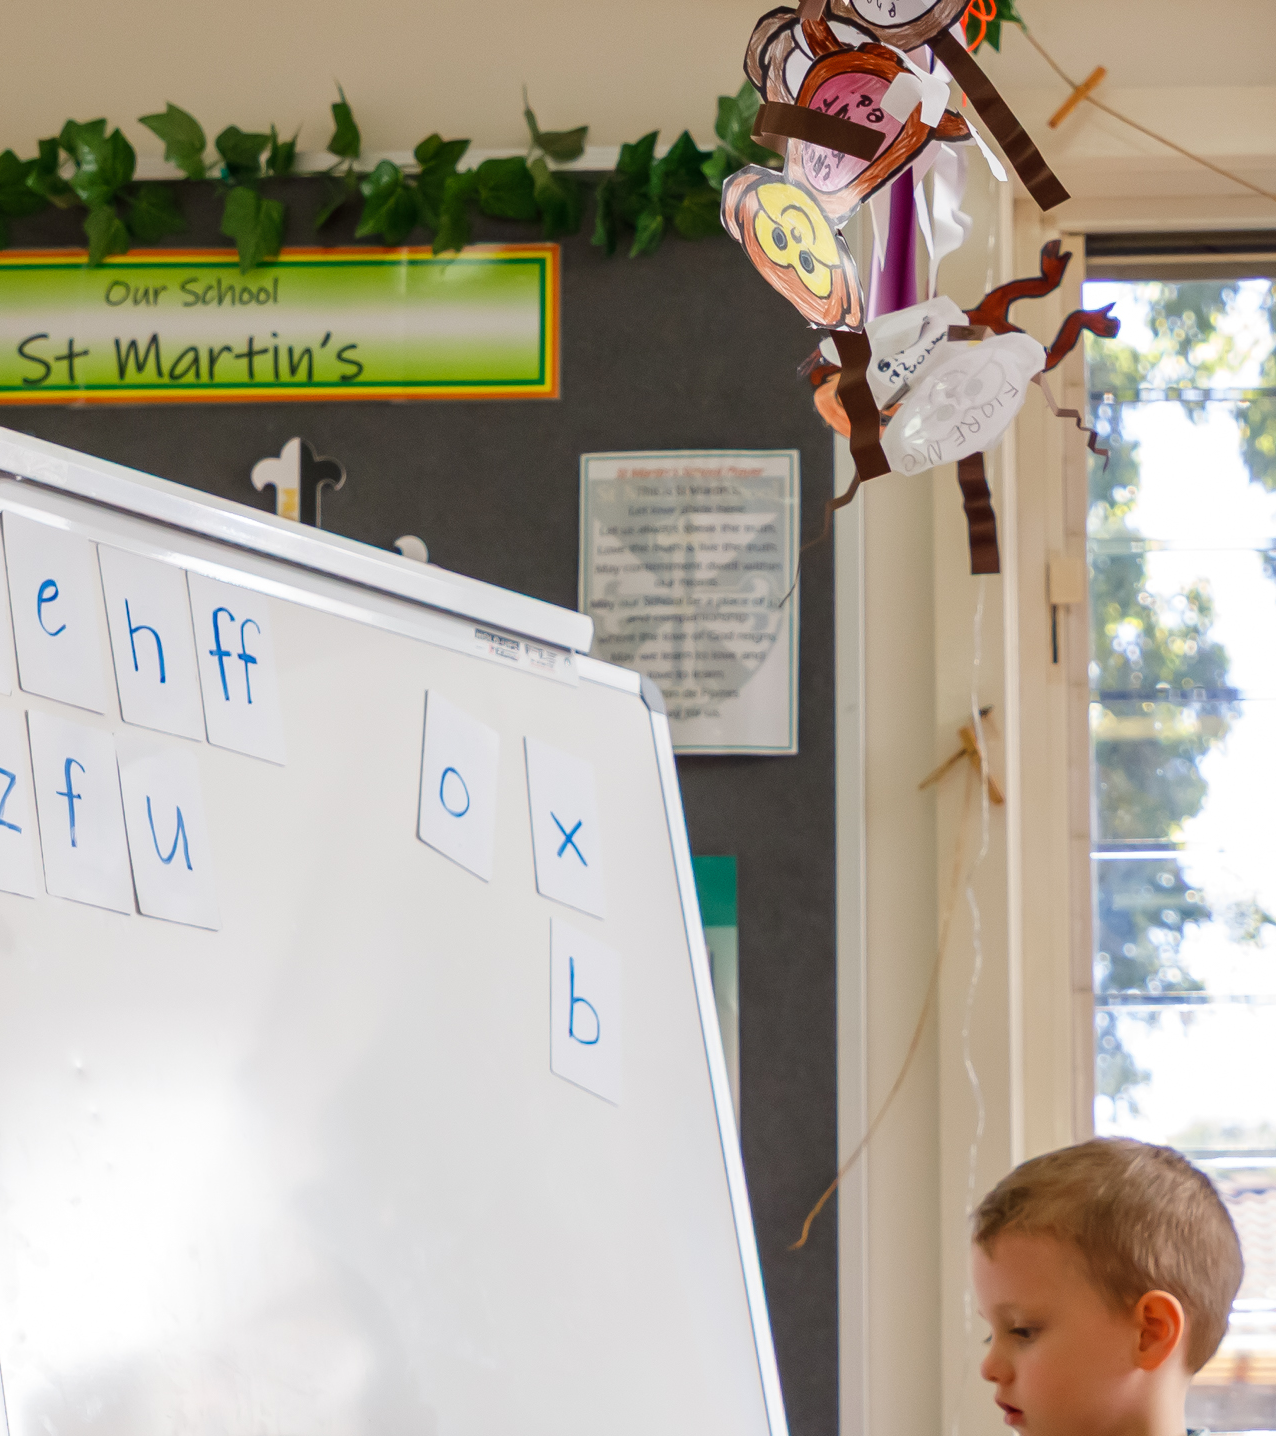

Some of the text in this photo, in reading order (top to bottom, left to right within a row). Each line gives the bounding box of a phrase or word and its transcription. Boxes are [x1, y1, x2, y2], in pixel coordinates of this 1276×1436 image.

[104, 276, 279, 307] Our School
[16, 329, 364, 386] St Martin's
[36, 578, 67, 637] e
[124, 597, 166, 684] h
[209, 606, 261, 705] ff
[55, 757, 86, 848] f
[145, 794, 193, 871] u
[439, 766, 588, 868] o x
[568, 955, 601, 1046] b
